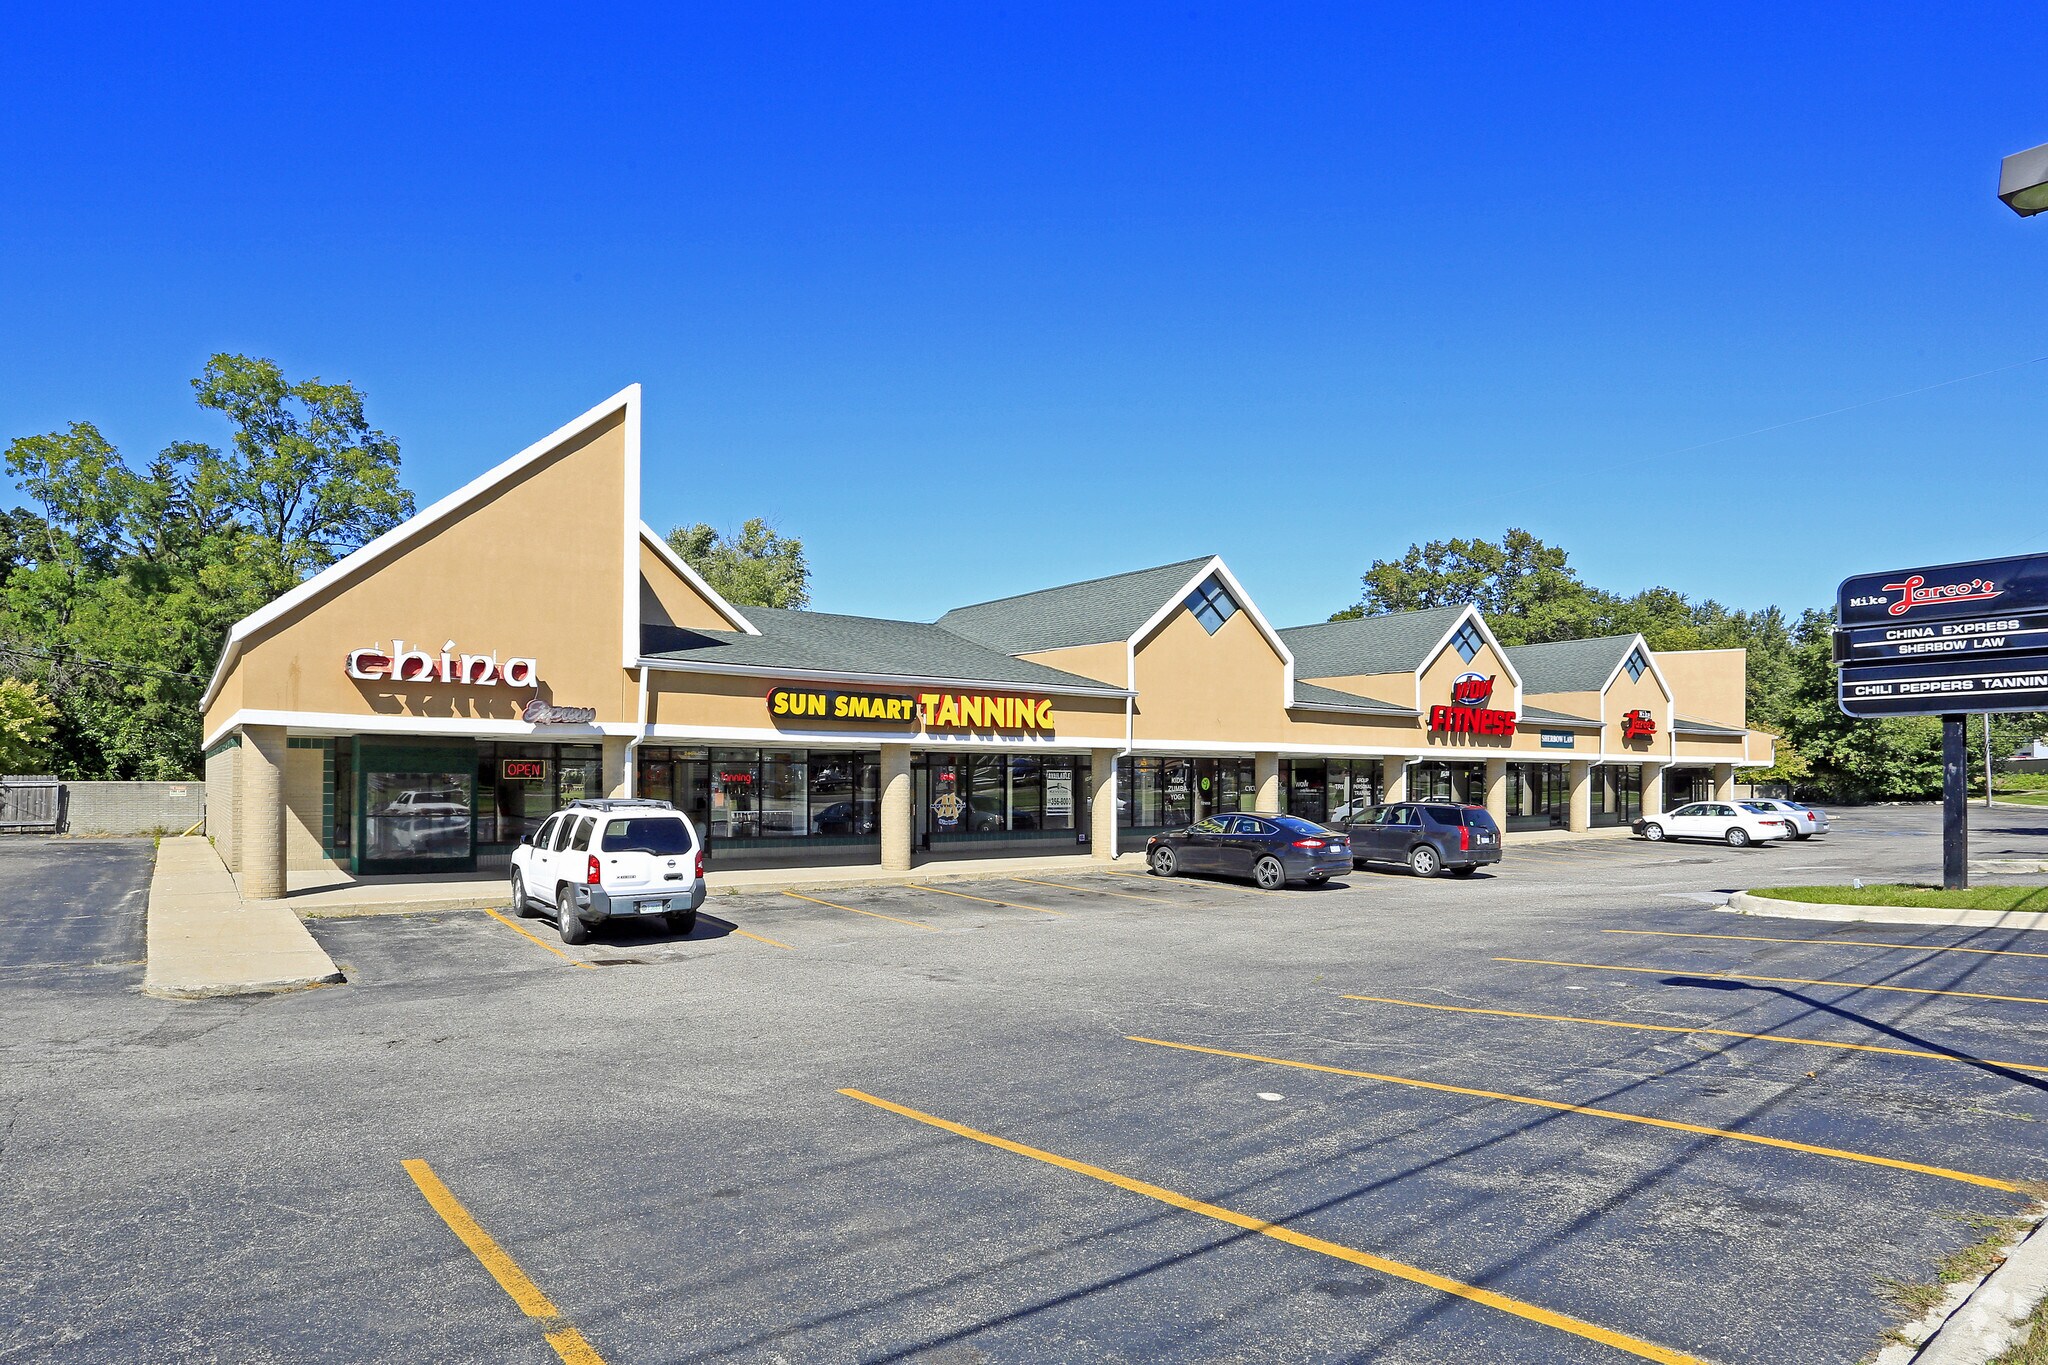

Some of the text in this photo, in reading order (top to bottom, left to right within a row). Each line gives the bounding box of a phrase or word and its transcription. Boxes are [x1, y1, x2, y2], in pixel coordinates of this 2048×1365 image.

[1850, 575, 2005, 616] Mike Larco's
[1886, 619, 2020, 640] CHINA EXPRESS
[1899, 637, 2006, 654] SHERBOW LAW
[1855, 685, 1892, 696] CHILI
[1900, 680, 1974, 693] PEPPERS
[773, 692, 1055, 729] SUN SMART TANNING
[1541, 734, 1573, 743] SHERBOW LAW
[507, 763, 541, 776] OPEN
[720, 771, 752, 784] Tanning
[1048, 772, 1071, 780] AVAILABLE
